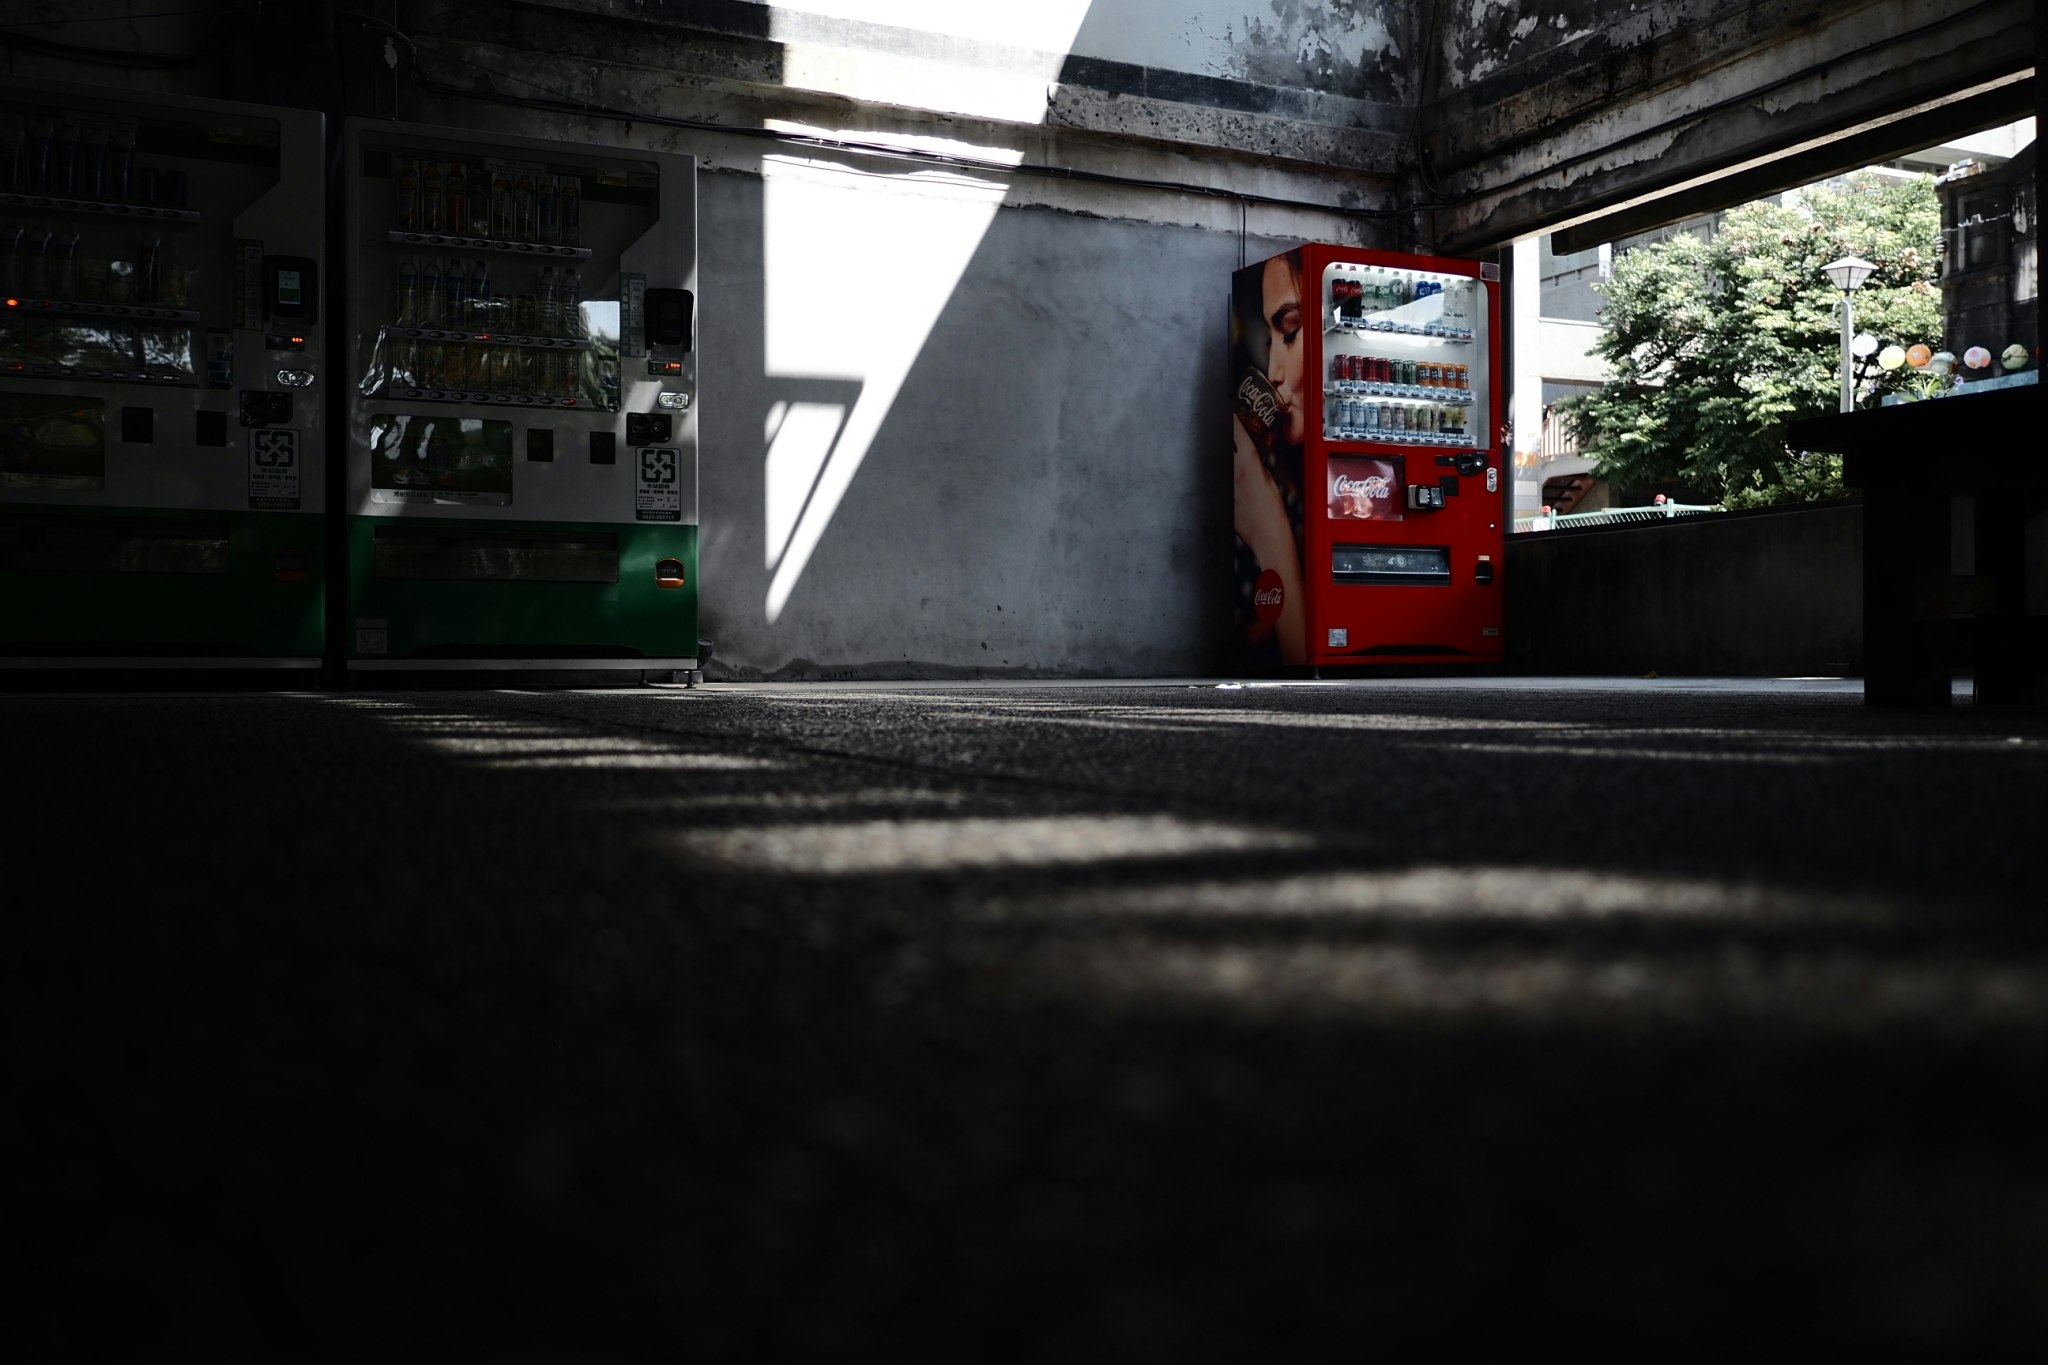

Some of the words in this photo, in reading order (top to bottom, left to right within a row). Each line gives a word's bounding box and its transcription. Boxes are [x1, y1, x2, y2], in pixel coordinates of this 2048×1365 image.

[1239, 376, 1280, 427] Coca-Cola
[1333, 474, 1391, 499] Coca-Cola
[1254, 587, 1282, 606] Coca-Cola
